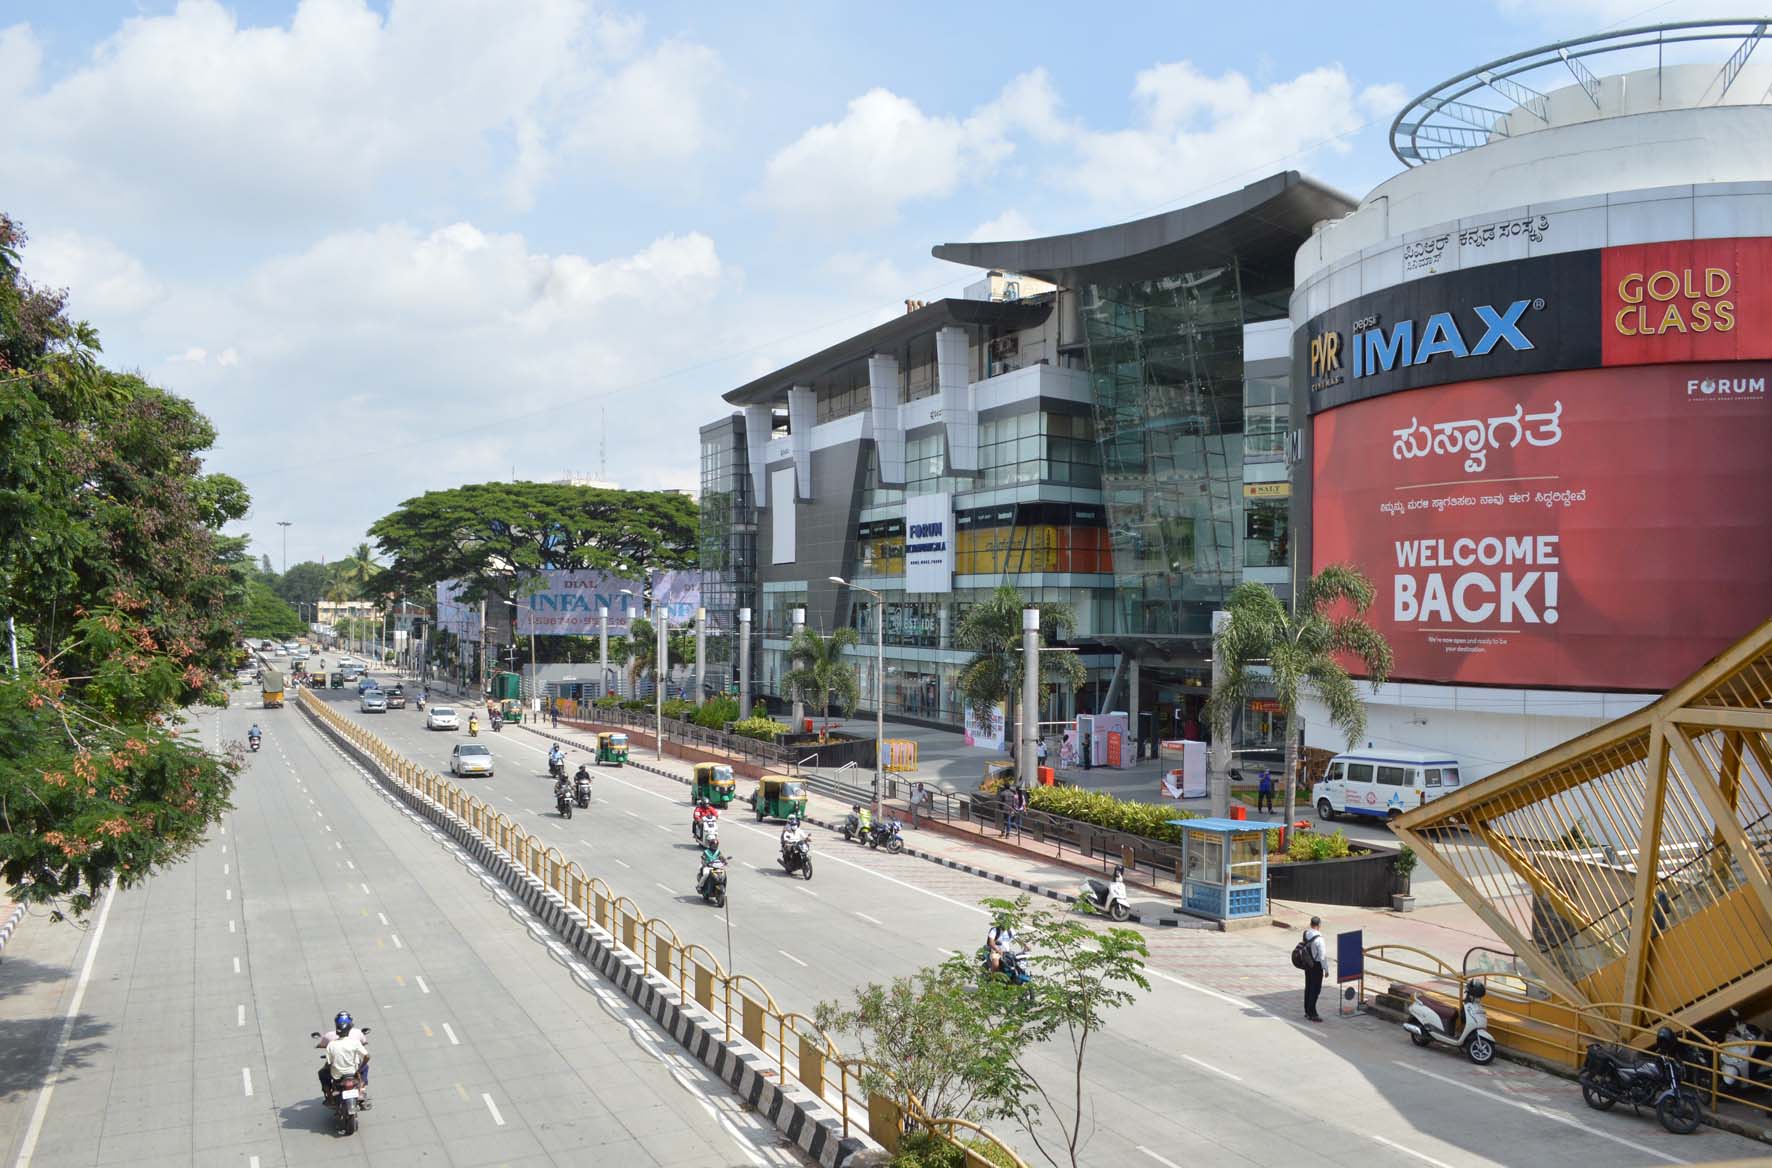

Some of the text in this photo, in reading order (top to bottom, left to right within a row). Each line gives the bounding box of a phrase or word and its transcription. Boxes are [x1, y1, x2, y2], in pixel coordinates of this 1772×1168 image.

[1459, 224, 1496, 247] ಕನ್ನಡ
[1499, 216, 1550, 242] ಸಂಸ್ಕೃತಿ
[1618, 267, 1732, 304] GOLD
[1352, 315, 1378, 332] pepsi
[1615, 300, 1736, 337] CLASS
[1311, 330, 1340, 377] PVR
[1687, 376, 1765, 395] FORUM
[1392, 399, 1563, 473] ಸುಸ್ವಾಗತ
[1395, 534, 1560, 568] WELCOME
[564, 580, 597, 589] DIAL
[1394, 571, 1560, 626] BACK!
[529, 592, 633, 612] INFANT
